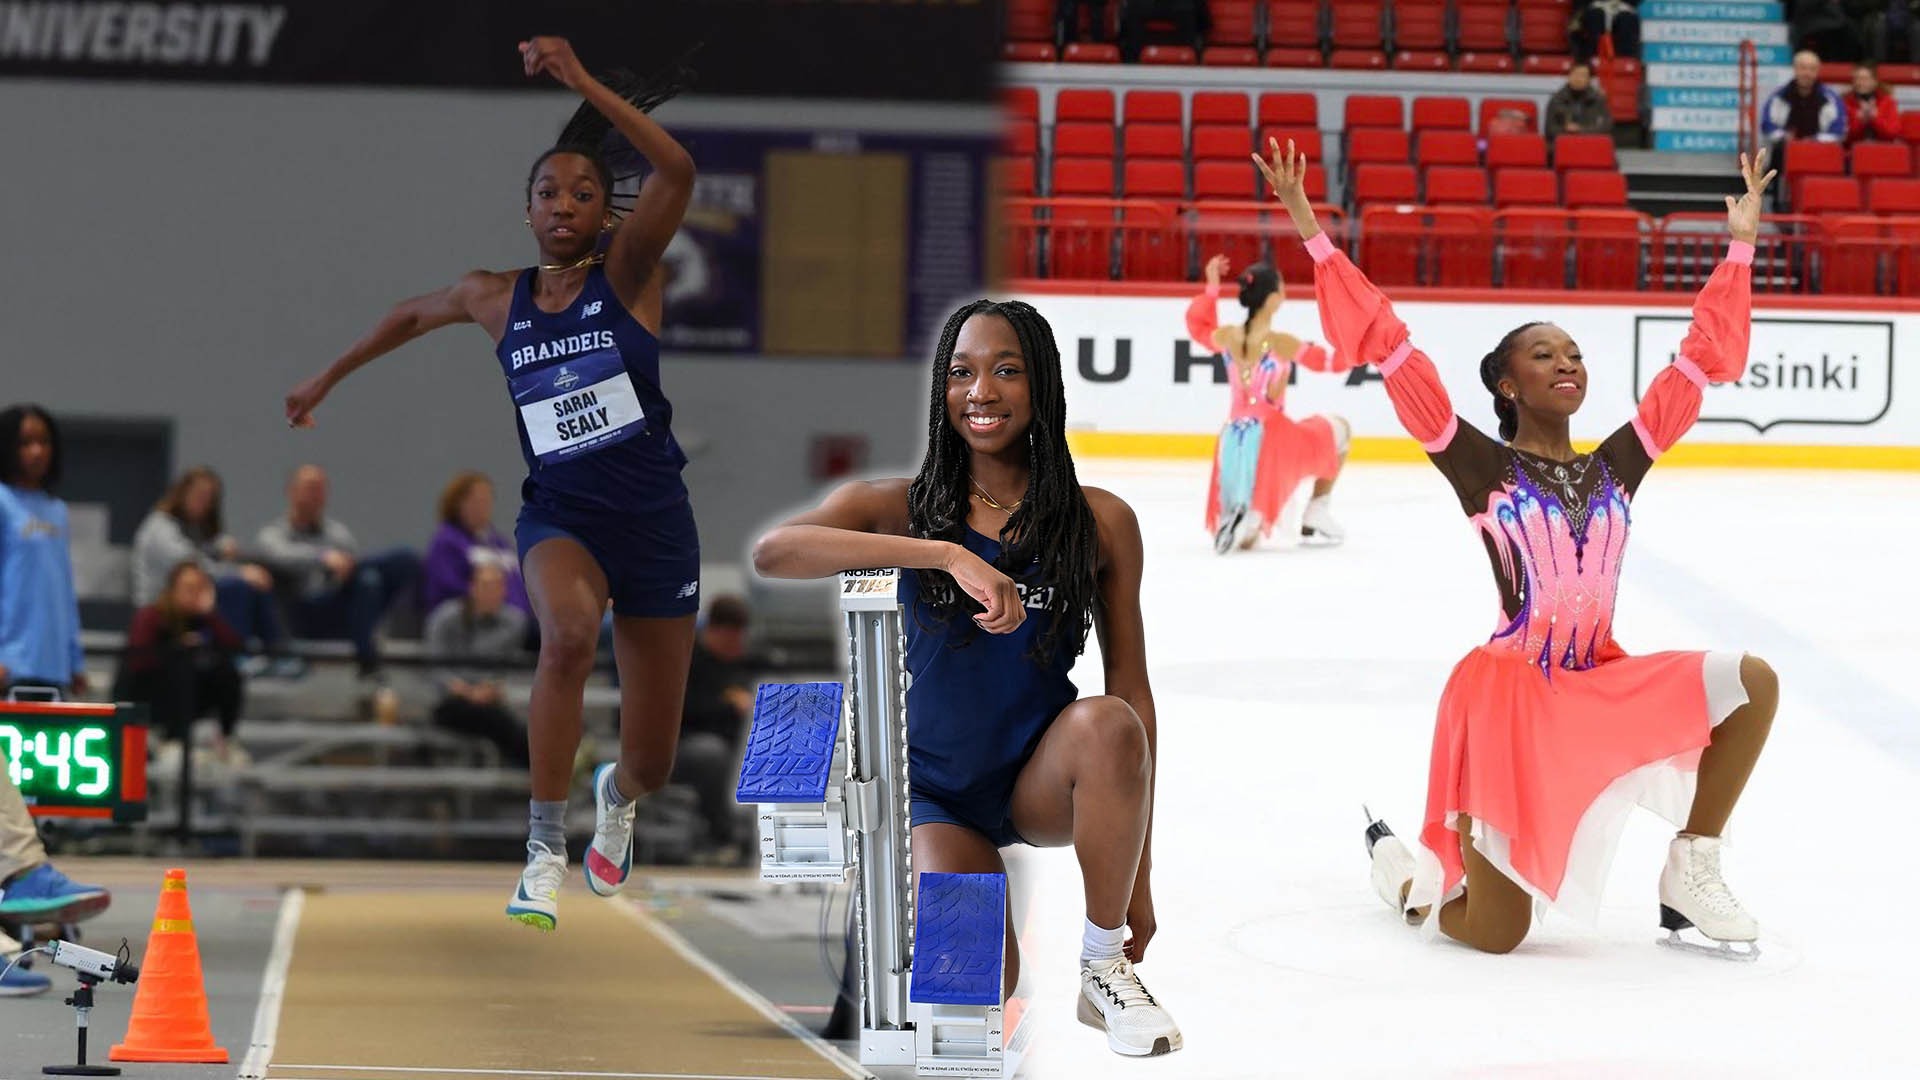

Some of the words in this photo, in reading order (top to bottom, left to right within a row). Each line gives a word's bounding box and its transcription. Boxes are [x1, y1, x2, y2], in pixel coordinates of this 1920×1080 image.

[511, 330, 614, 370] BRANDEIS
[553, 390, 598, 418] SARAI
[556, 407, 609, 441] SEALY
[844, 569, 894, 577] FUSION
